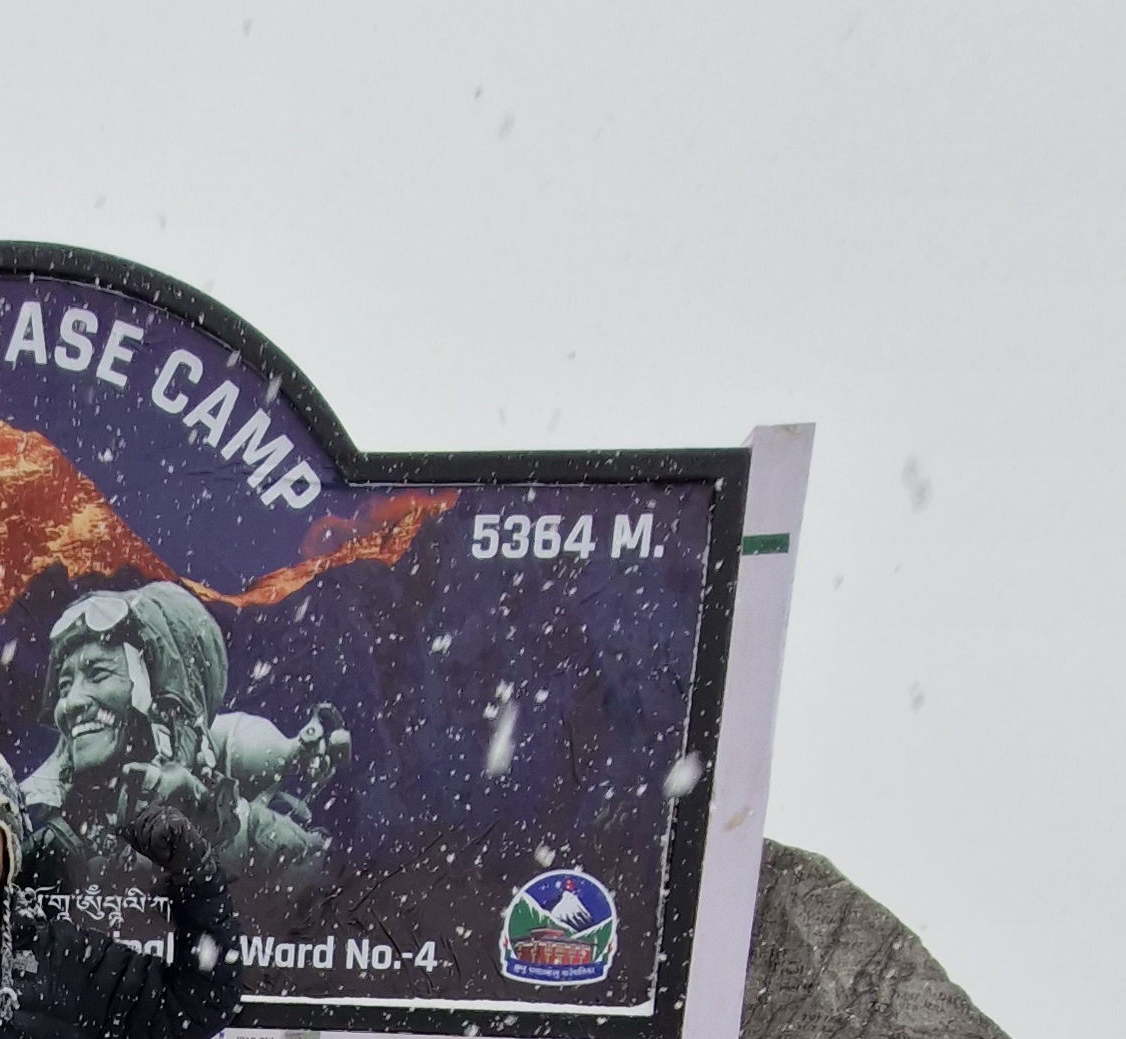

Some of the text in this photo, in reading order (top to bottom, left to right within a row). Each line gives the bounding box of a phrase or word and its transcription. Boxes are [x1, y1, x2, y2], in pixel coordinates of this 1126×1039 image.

[151, 349, 321, 509] CAMP
[471, 513, 664, 560] 5364 M.
[239, 935, 438, 972] Ward No.-4
